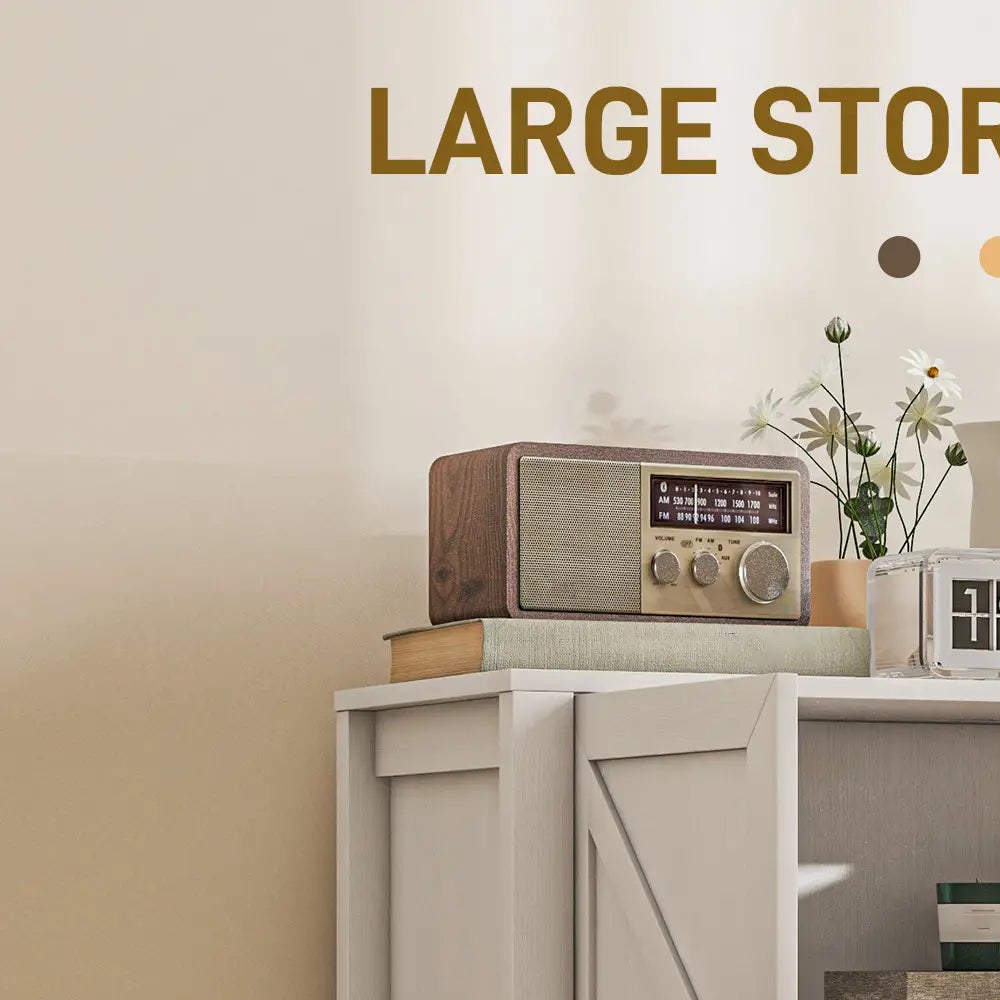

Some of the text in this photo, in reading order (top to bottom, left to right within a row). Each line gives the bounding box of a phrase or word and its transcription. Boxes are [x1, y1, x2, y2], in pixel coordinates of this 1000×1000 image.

[658, 496, 670, 504] AM
[673, 497, 684, 505] 530
[684, 497, 694, 506] 700
[714, 499, 728, 507] 1200
[732, 500, 745, 508] 1500
[747, 500, 761, 509] 1700
[659, 512, 670, 520] FM
[685, 513, 692, 521] 90
[699, 514, 707, 522] 94
[707, 514, 715, 523] 96
[721, 515, 731, 523] 100
[735, 515, 745, 524] 104
